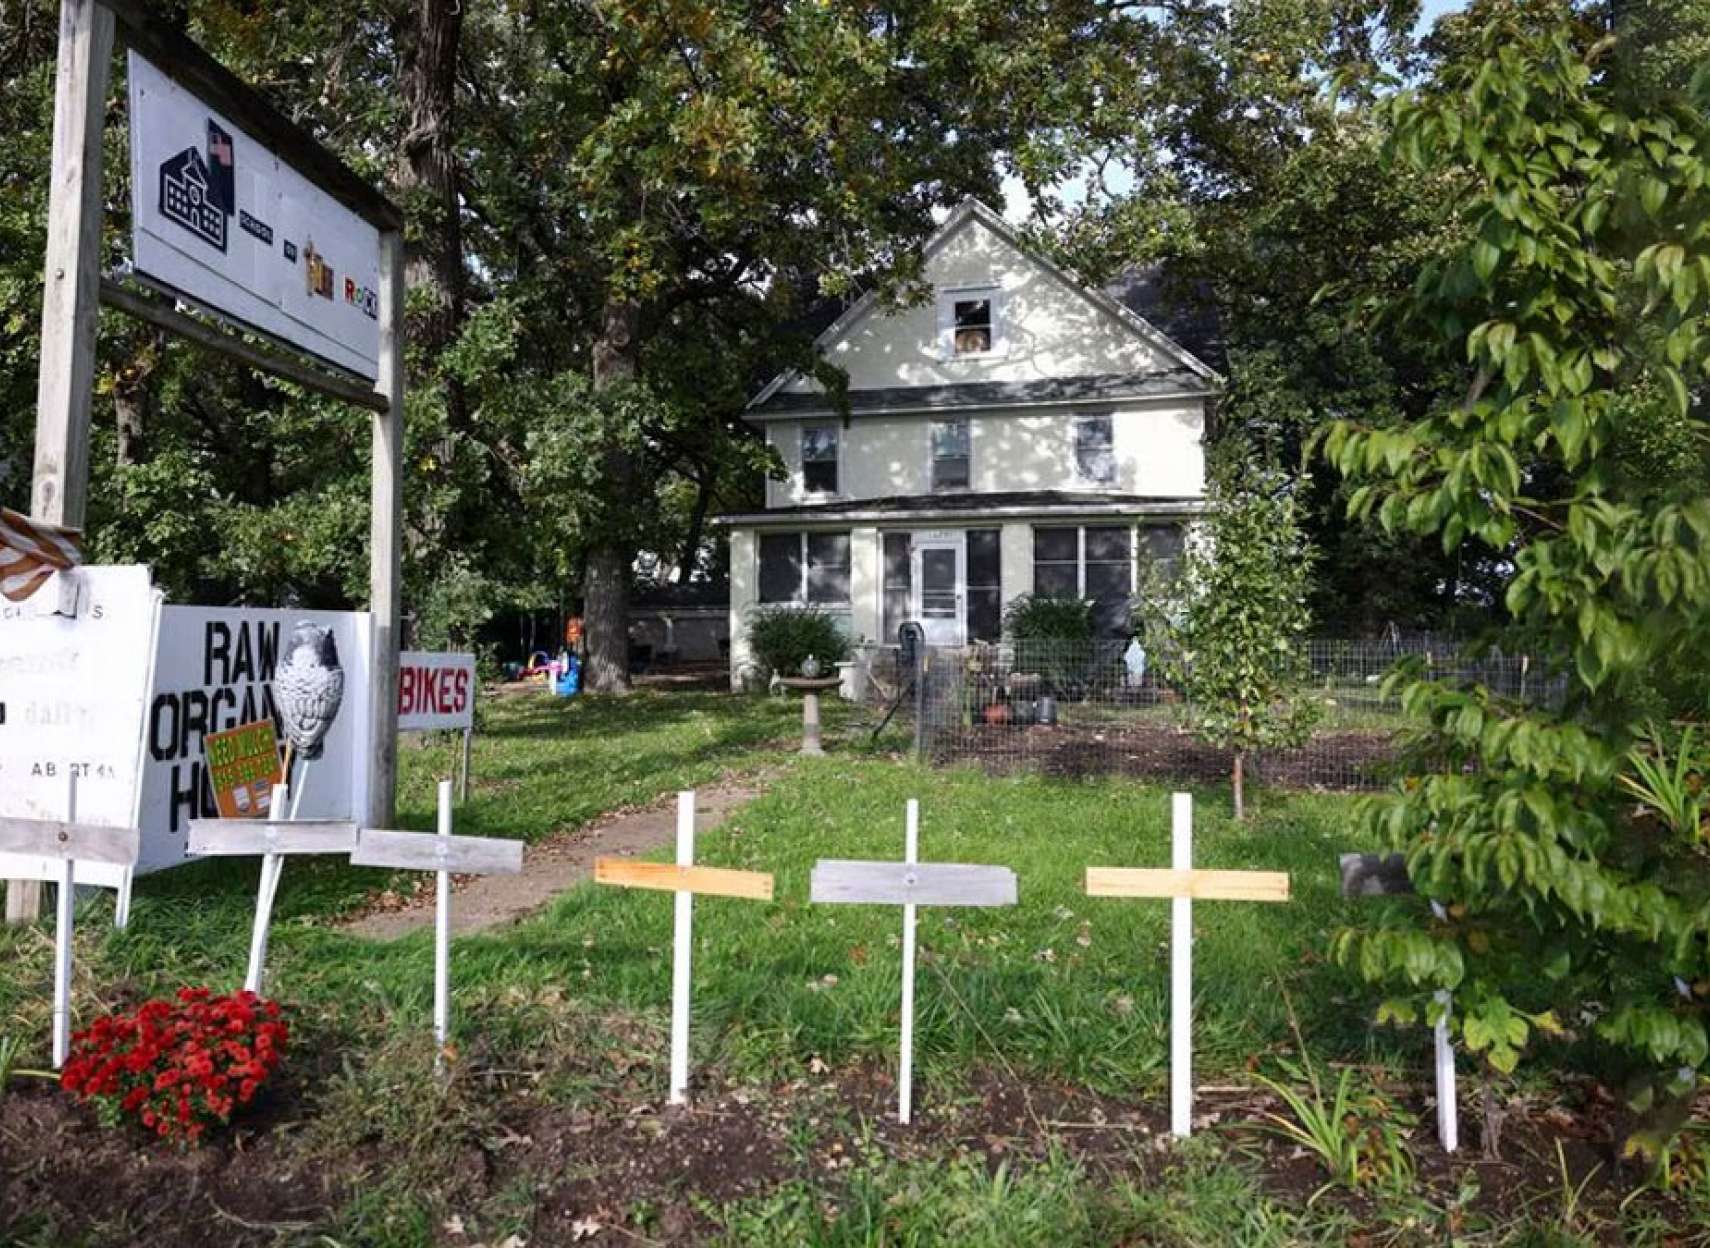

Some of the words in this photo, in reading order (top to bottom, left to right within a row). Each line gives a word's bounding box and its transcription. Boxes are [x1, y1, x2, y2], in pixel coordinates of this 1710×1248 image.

[204, 620, 280, 686] RAW
[150, 684, 284, 761] ORGAN
[397, 666, 469, 715] BIKES
